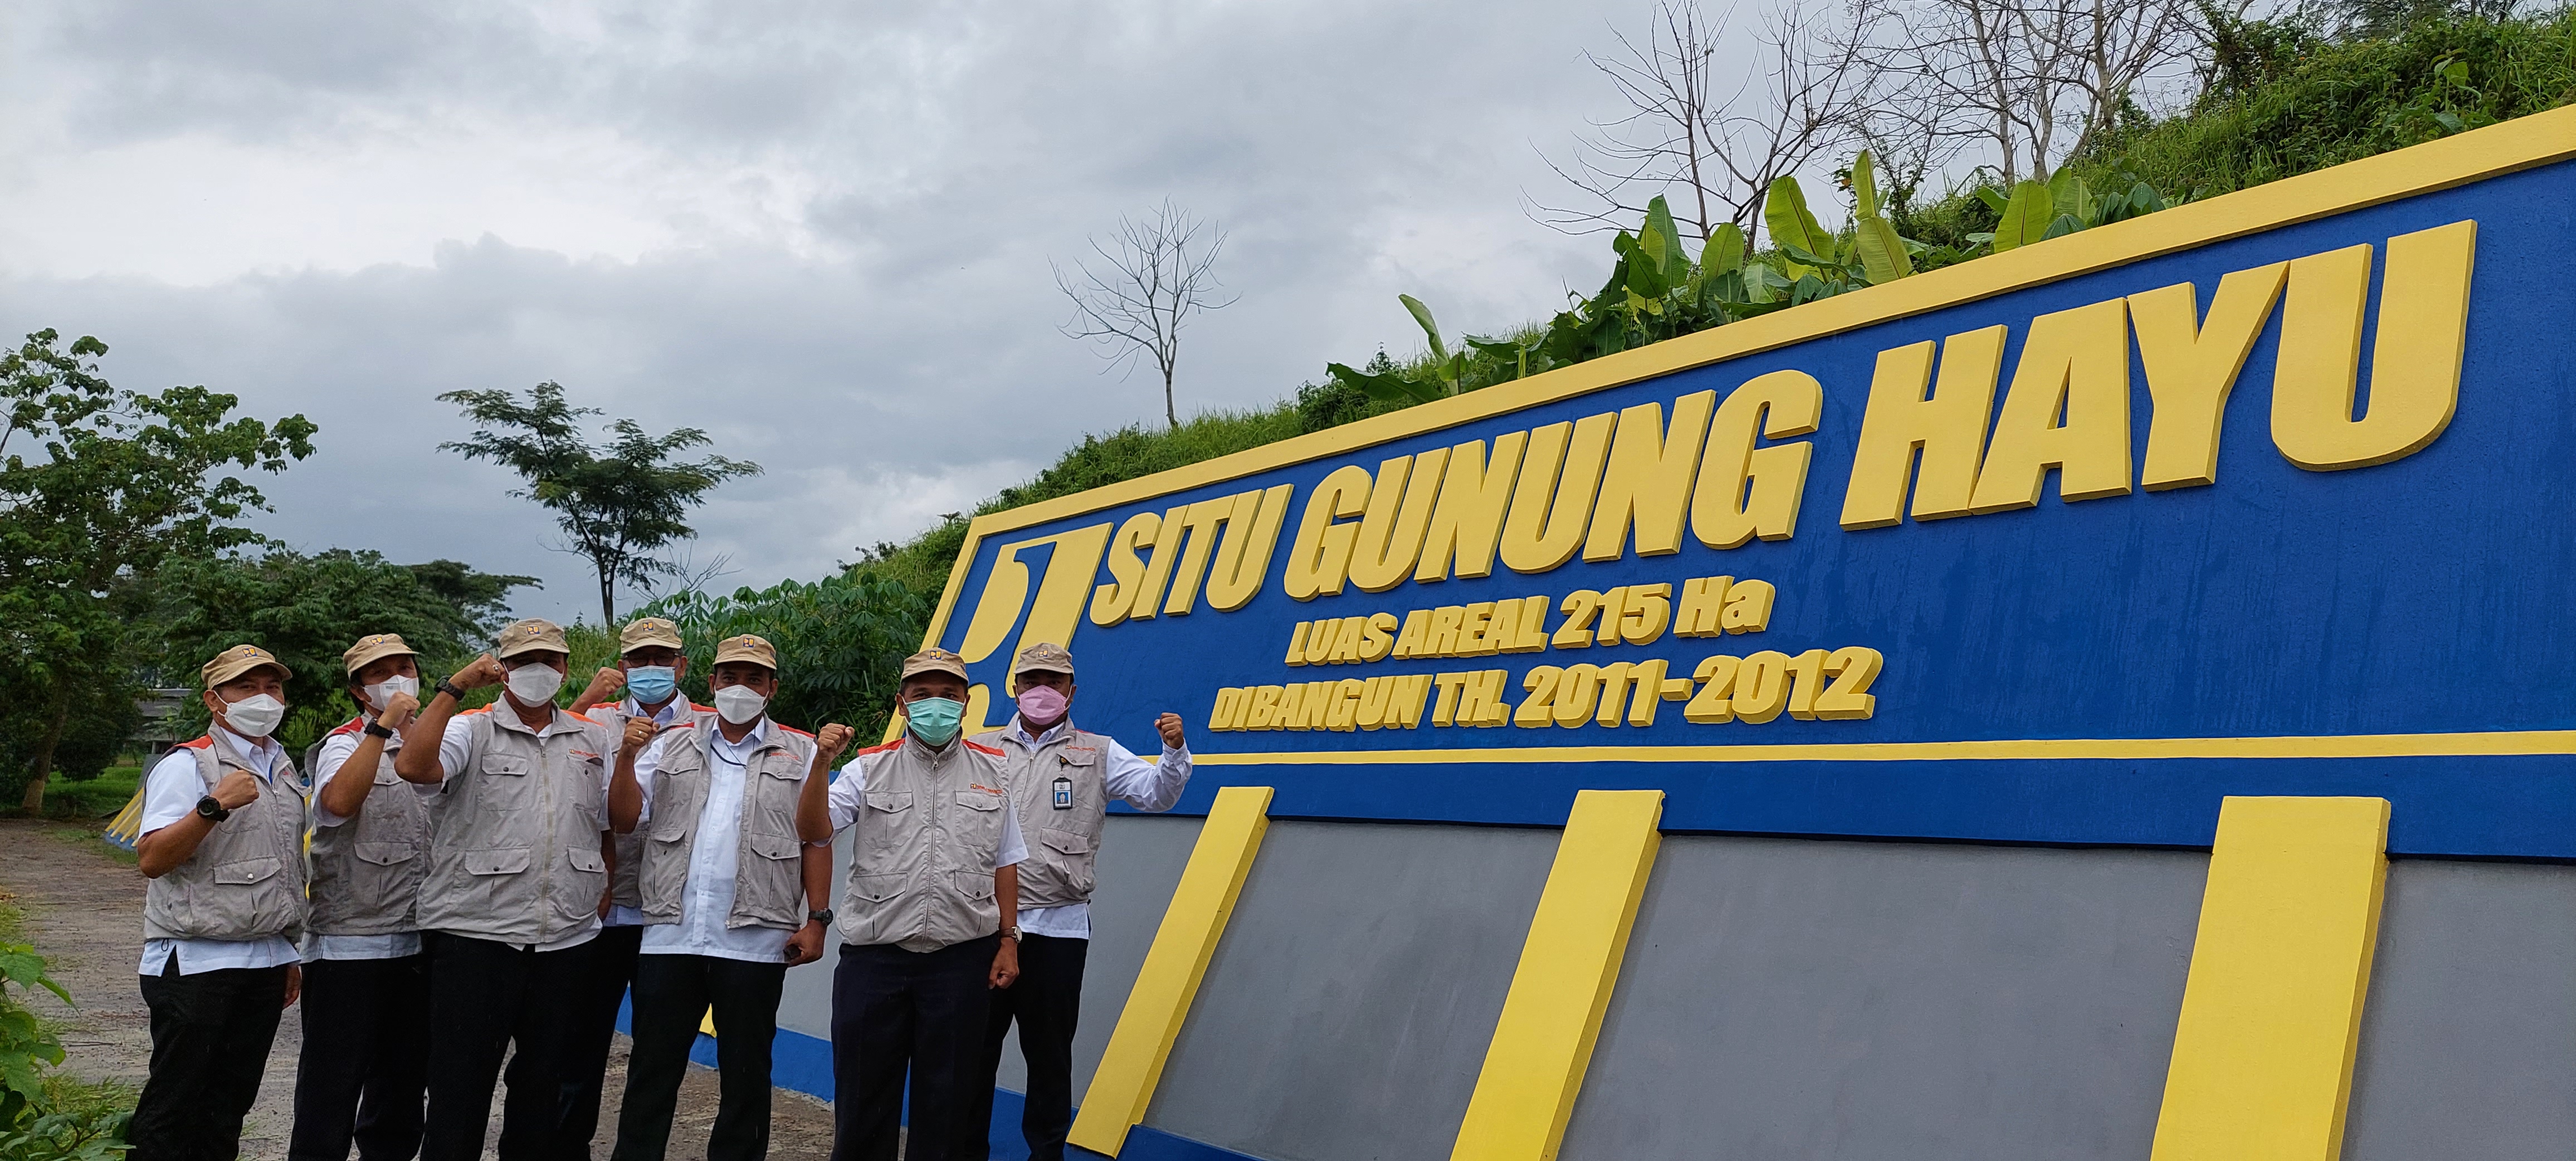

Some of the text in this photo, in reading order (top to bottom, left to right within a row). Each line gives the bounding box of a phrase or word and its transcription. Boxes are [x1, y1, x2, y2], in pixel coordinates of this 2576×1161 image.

[1091, 221, 2477, 627] SITU GUNUNG HAYU
[1285, 575, 1775, 666] LUAS AREAL 215 Ha
[1208, 646, 1883, 732] DIBANGUN TH. 2011-2012
